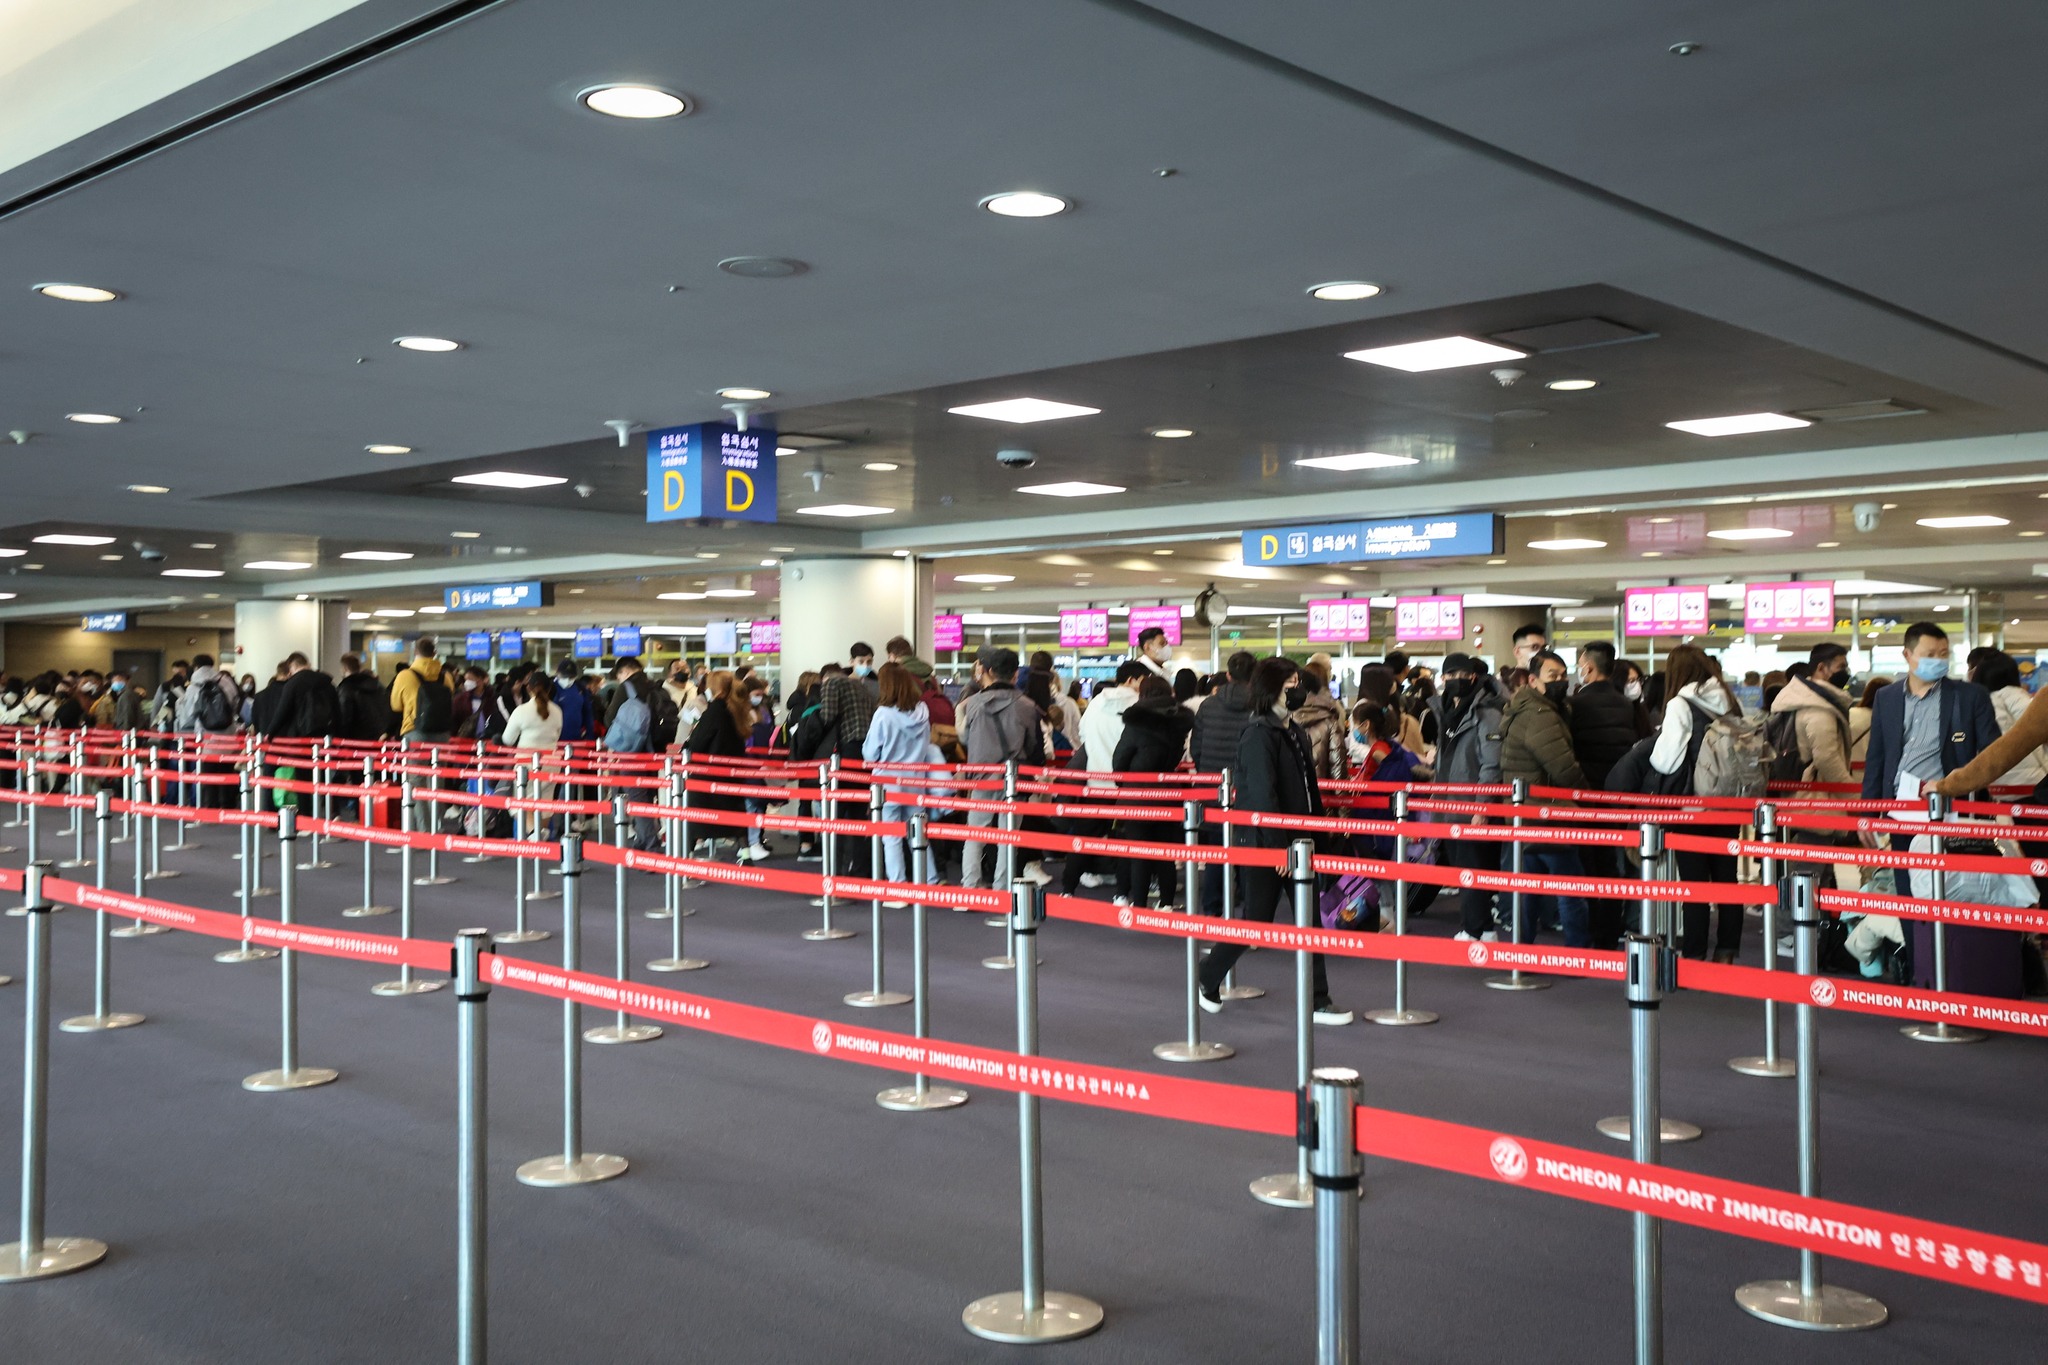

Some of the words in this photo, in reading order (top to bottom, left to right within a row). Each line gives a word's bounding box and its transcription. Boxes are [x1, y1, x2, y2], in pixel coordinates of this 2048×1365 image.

[664, 470, 685, 512] D
[726, 469, 755, 512] D
[1261, 534, 1279, 560] D
[1819, 894, 1859, 907] AIRPORT
[1861, 898, 1929, 915] IMMIGRATION
[1932, 905, 2048, 926] 인천공항출입국관리사무
[1136, 915, 1170, 929] INCHEON
[1170, 919, 1204, 933] AIRPORT
[1205, 924, 1262, 940] IMMIGRATION
[1493, 950, 1538, 965] INCHEON
[1540, 954, 1586, 969] AIRPORT
[1589, 958, 1627, 973] IMMIG
[1842, 989, 1903, 1009] INCHEON
[1906, 997, 1968, 1017] AIRPORT
[835, 1034, 880, 1055] INCHEON
[881, 1042, 926, 1063] AIRPORT
[928, 1050, 1004, 1077] IMMIGRATION
[1535, 1156, 1623, 1193] INCHEON
[1626, 1177, 1717, 1213] AIRPORT
[1722, 1197, 1882, 1250] IMMIGRATION
[1890, 1233, 2048, 1287] 인천공항출입
